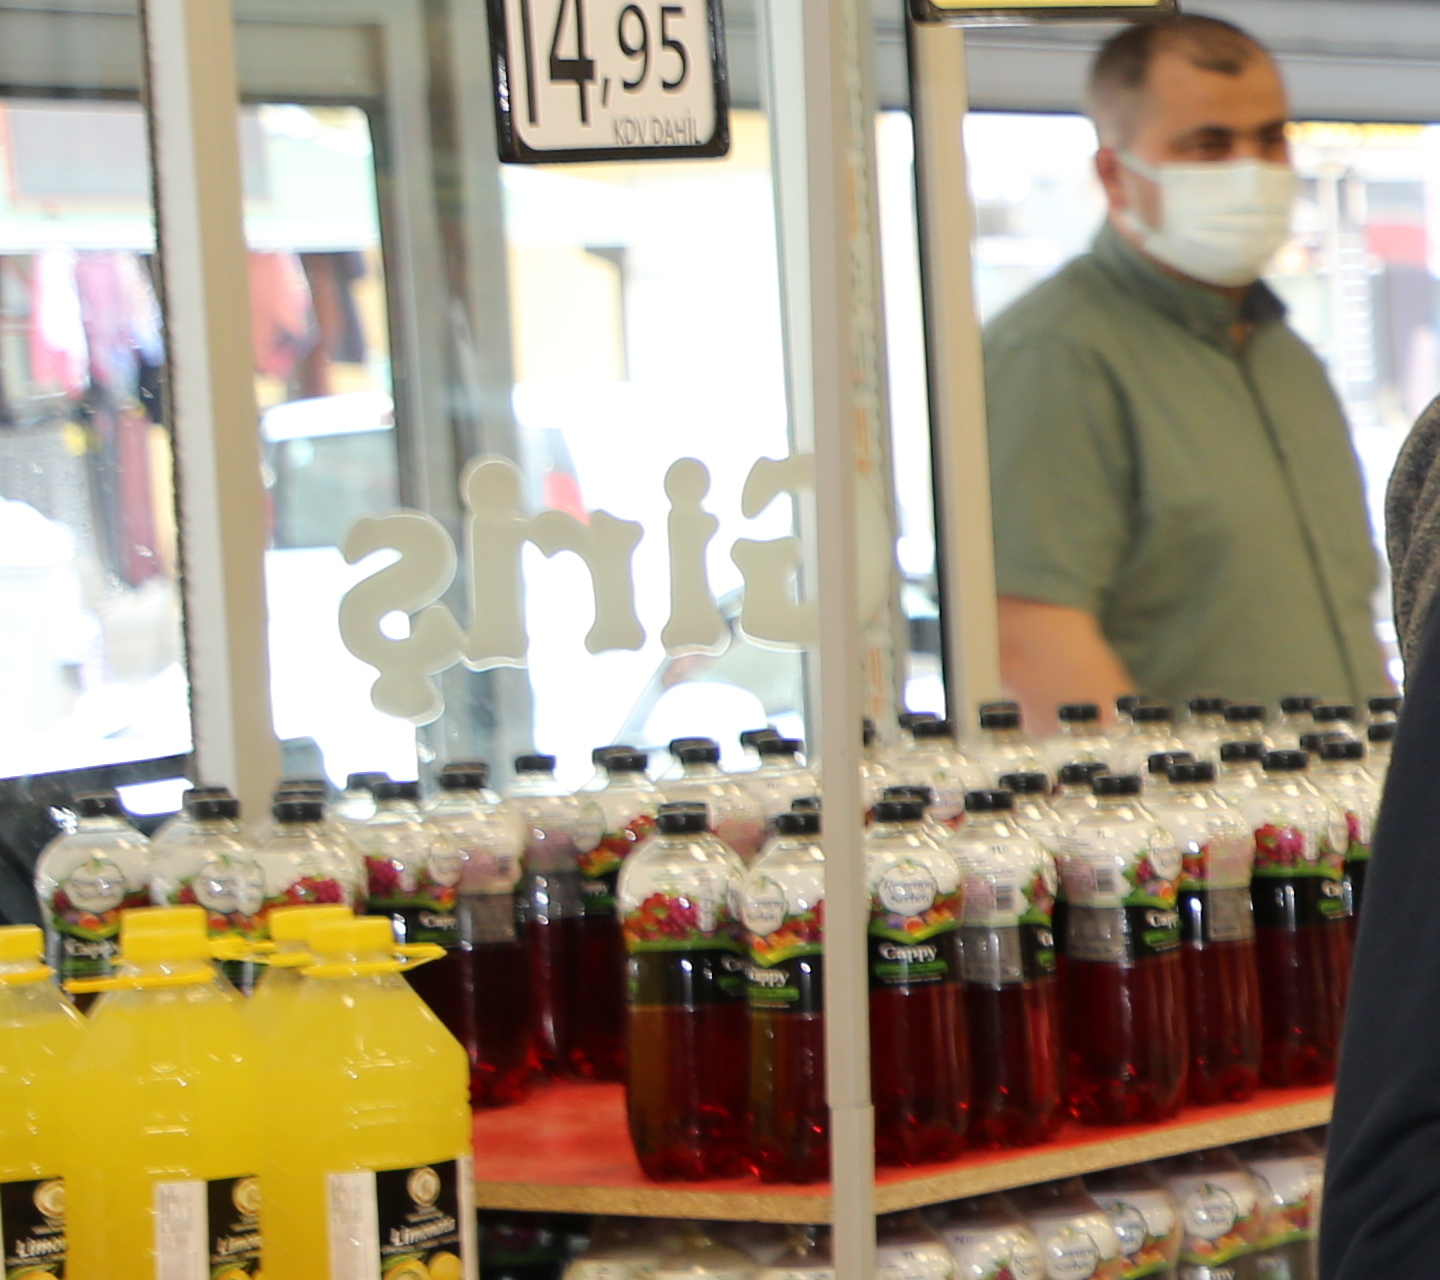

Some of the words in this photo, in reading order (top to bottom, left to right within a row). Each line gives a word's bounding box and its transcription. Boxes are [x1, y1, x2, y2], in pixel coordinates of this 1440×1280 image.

[614, 118, 649, 145] KDV
[652, 109, 703, 146] DAHİL
[879, 942, 938, 964] Cappy
